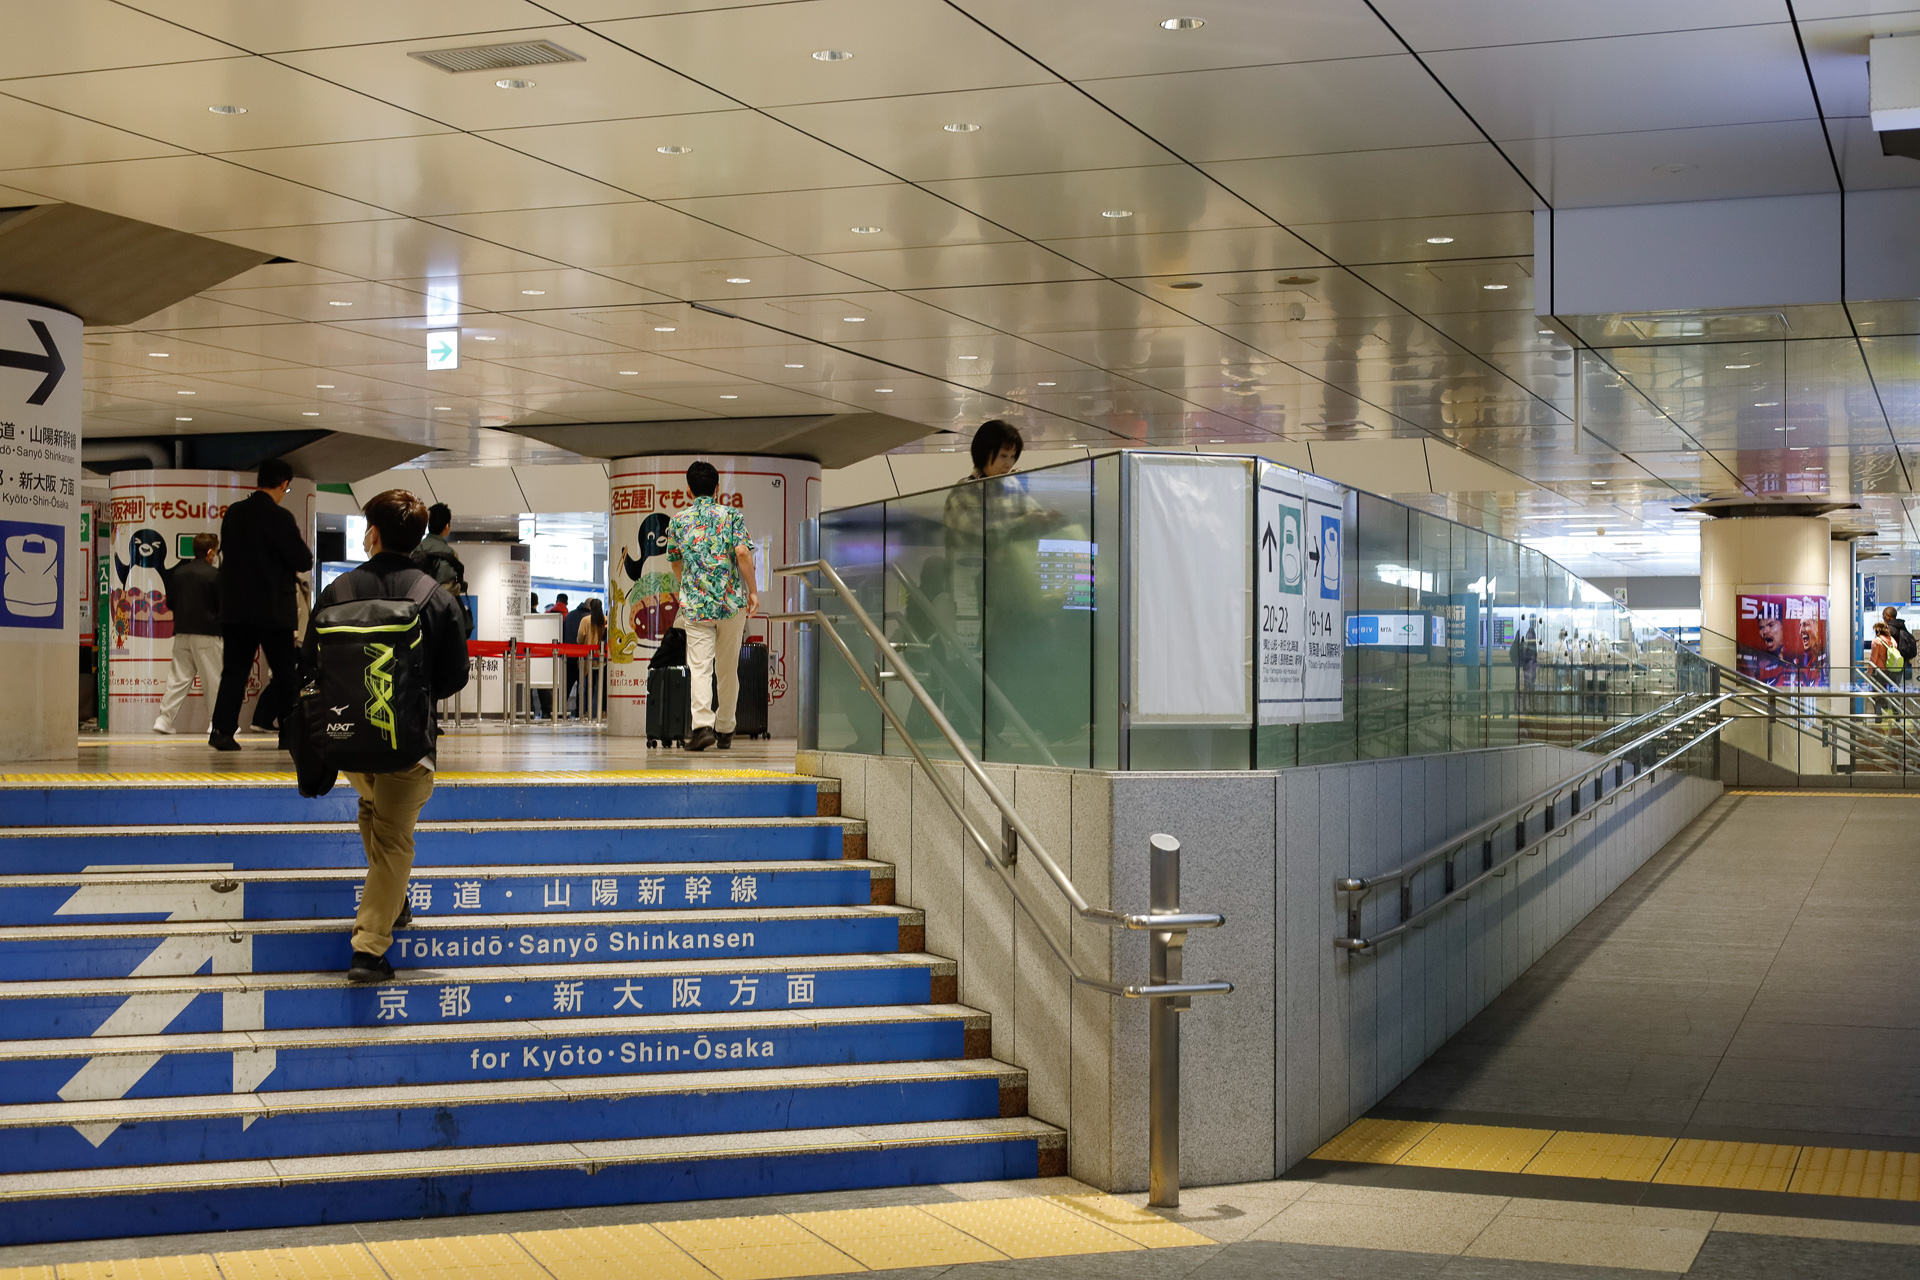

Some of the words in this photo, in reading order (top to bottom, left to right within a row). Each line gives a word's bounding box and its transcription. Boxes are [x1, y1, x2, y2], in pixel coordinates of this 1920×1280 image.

[45, 449, 75, 464] Shinkansen
[60, 477, 74, 496] 方面
[100, 567, 108, 595] 入口
[326, 723, 355, 732] NXT
[609, 930, 755, 952] Shinkansen
[471, 1049, 510, 1070] for
